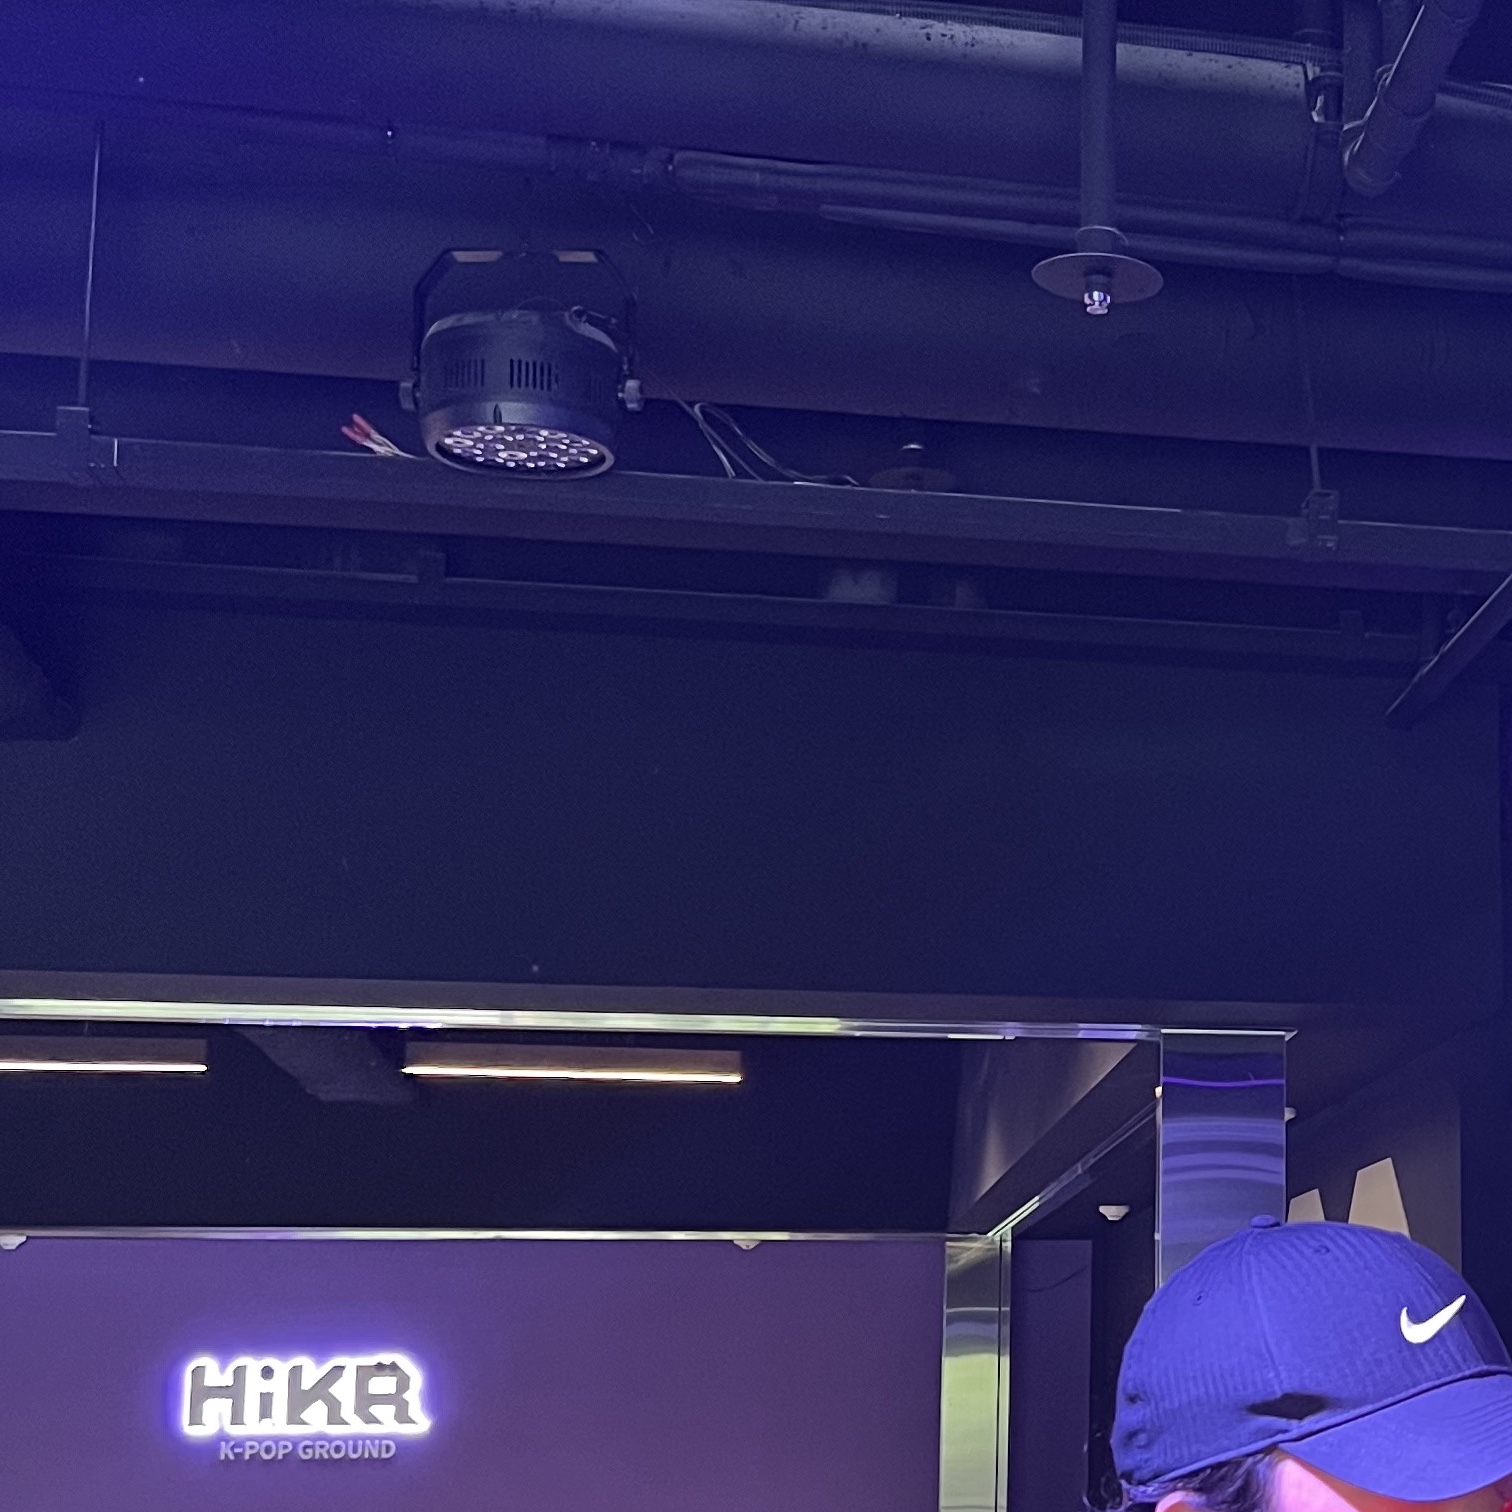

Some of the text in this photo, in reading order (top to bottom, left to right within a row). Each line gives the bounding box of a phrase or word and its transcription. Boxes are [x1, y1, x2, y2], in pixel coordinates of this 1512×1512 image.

[187, 1360, 420, 1427] HiKR
[219, 1440, 397, 1460] K-POP GROUND
